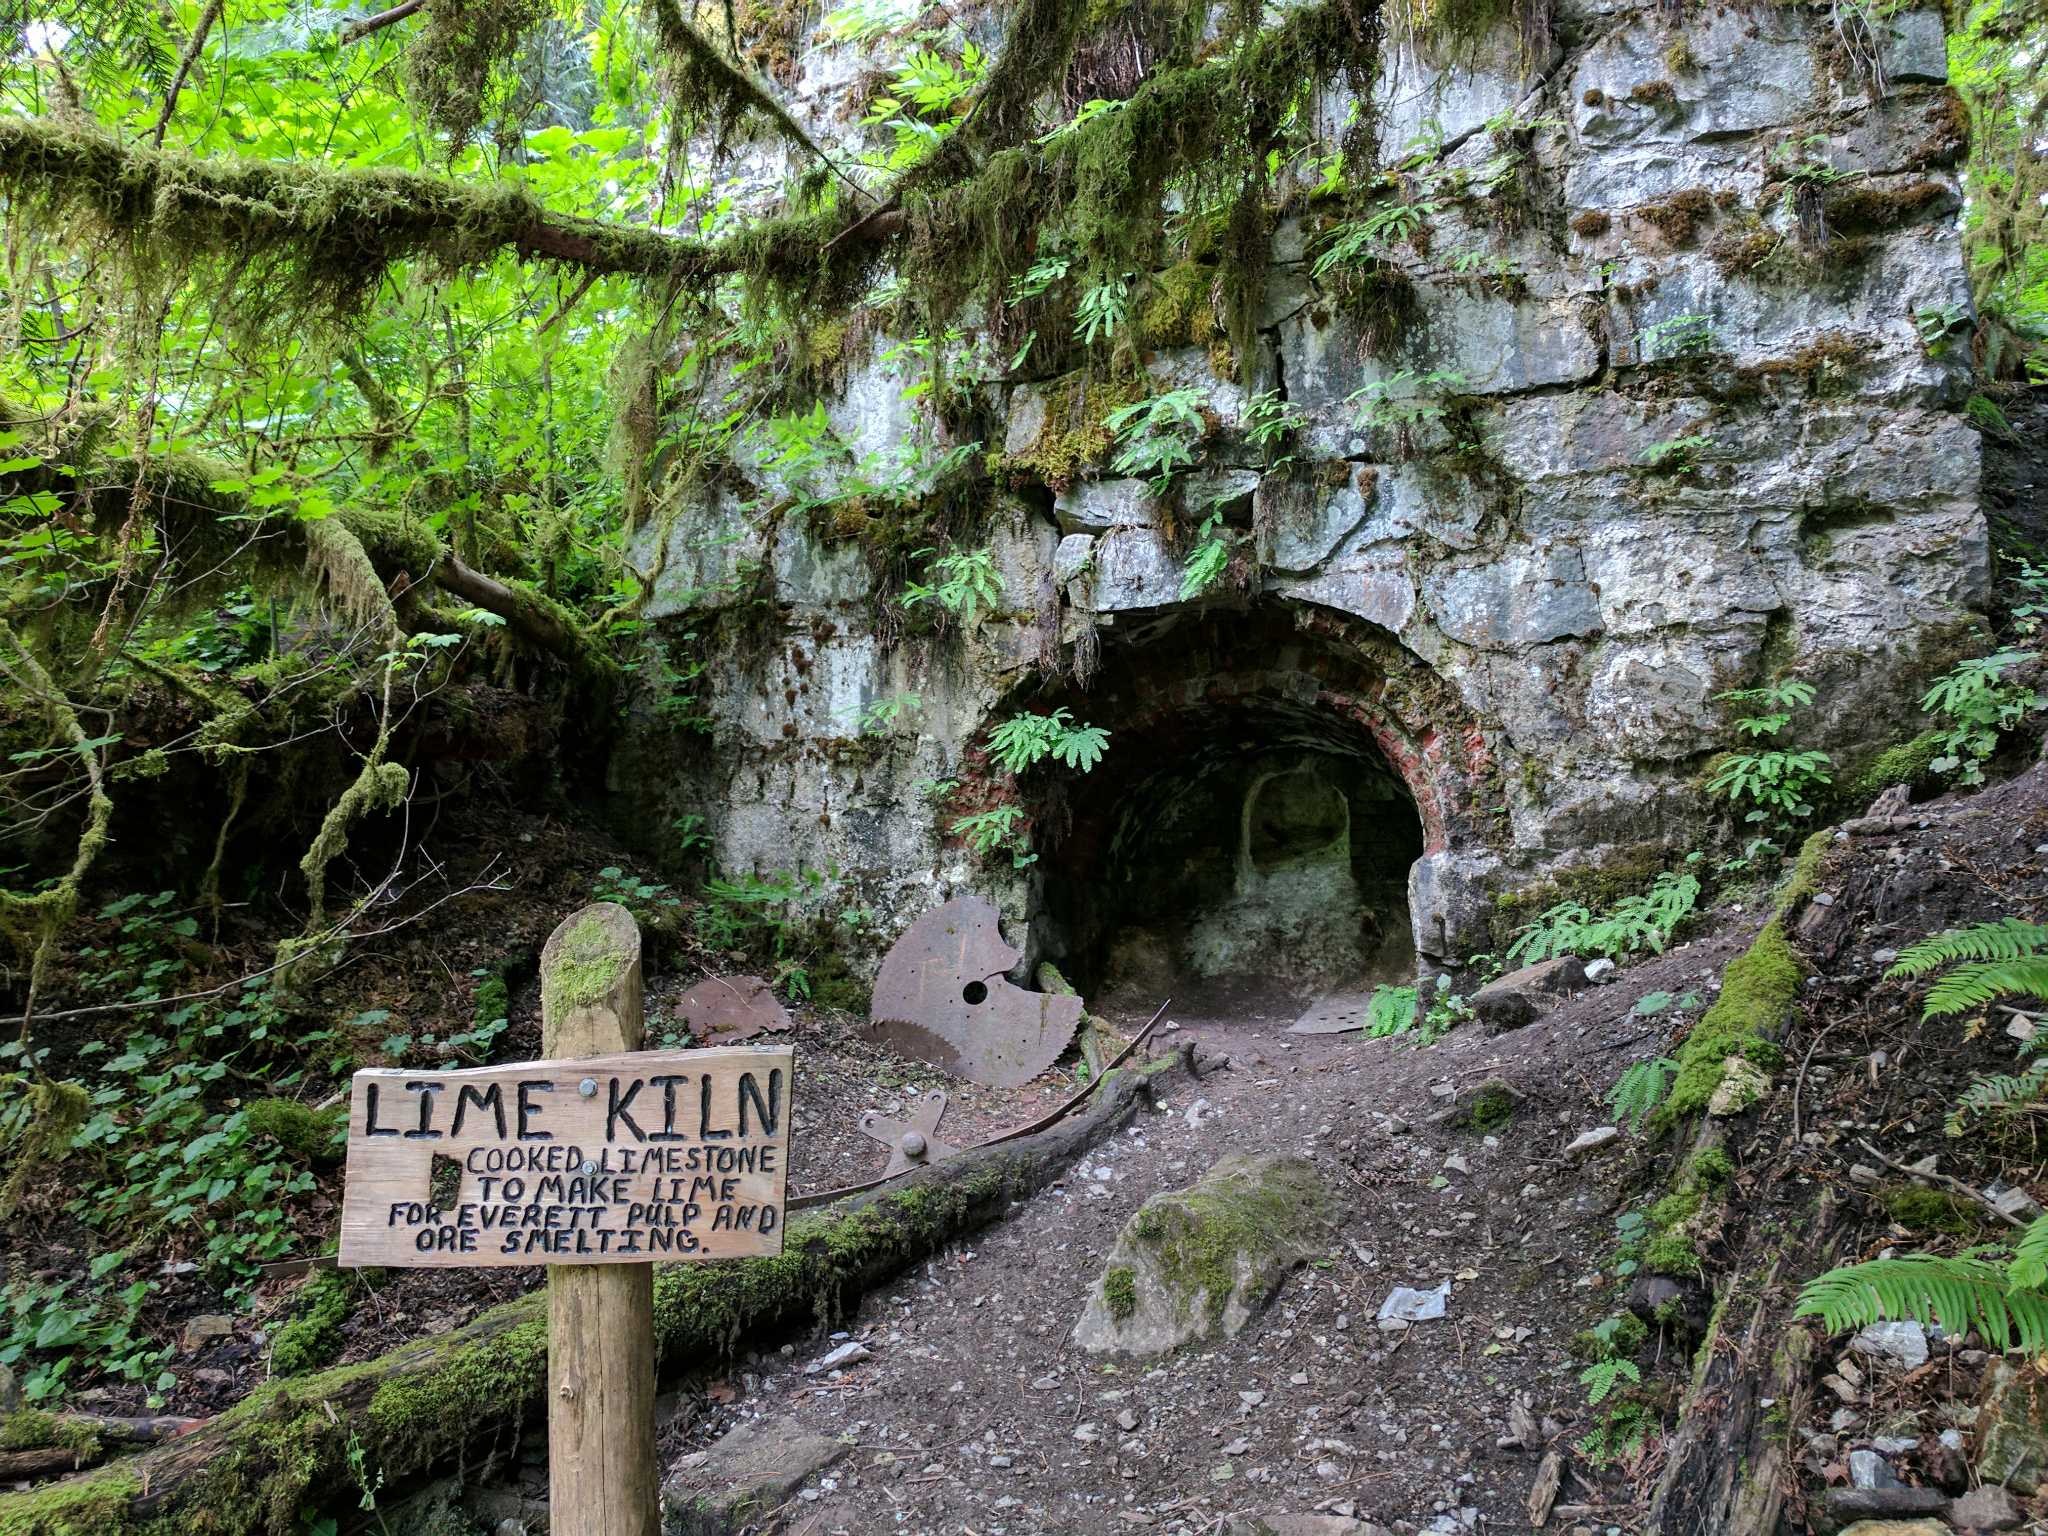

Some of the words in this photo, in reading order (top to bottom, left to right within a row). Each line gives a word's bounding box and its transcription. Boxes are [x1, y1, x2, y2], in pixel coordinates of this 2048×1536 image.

[366, 1079, 555, 1141] LIME
[606, 1068, 784, 1143] KILN
[466, 1146, 582, 1175] COOKED
[599, 1145, 777, 1175] LIMESTONE
[479, 1176, 525, 1204] TO
[536, 1176, 629, 1204] MAKE
[653, 1177, 742, 1203] LIME
[388, 1201, 441, 1227] FOR
[457, 1204, 602, 1229] EVERETT
[627, 1203, 700, 1228] PULP
[711, 1204, 778, 1235] AND
[416, 1225, 479, 1253] ORE
[500, 1227, 711, 1255] SMELTING.
